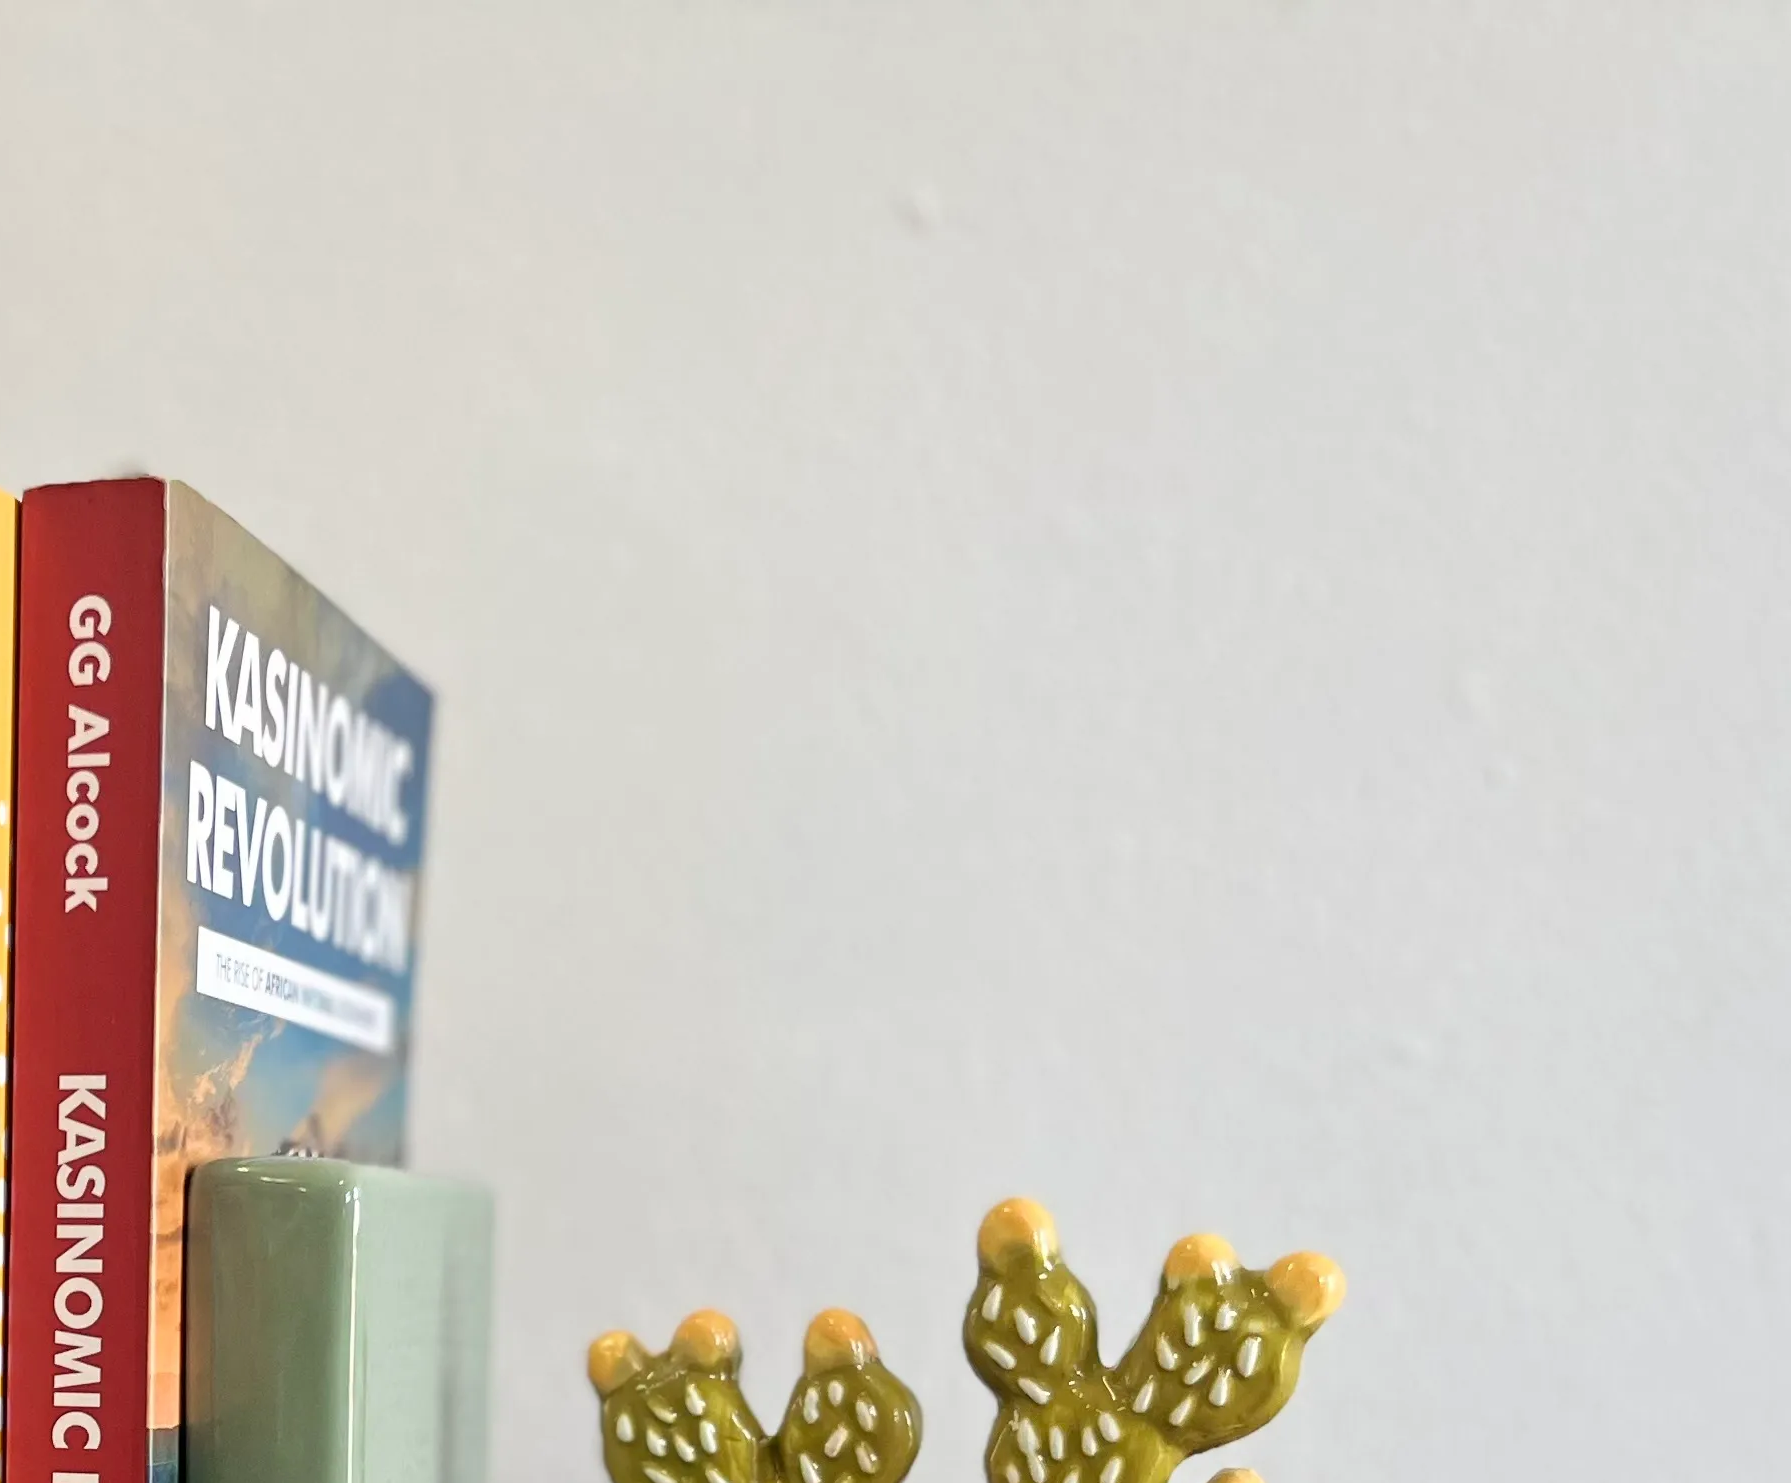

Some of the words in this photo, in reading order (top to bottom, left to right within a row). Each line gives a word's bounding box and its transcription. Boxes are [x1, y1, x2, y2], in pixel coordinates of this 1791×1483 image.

[67, 594, 112, 687] GG
[205, 604, 412, 846] KASINOMIC
[64, 703, 111, 914] Alcock
[186, 760, 408, 976] REVOLUTION
[216, 953, 231, 983] THE
[233, 960, 250, 989] RISE
[51, 1074, 107, 1451] KASINOMIC
